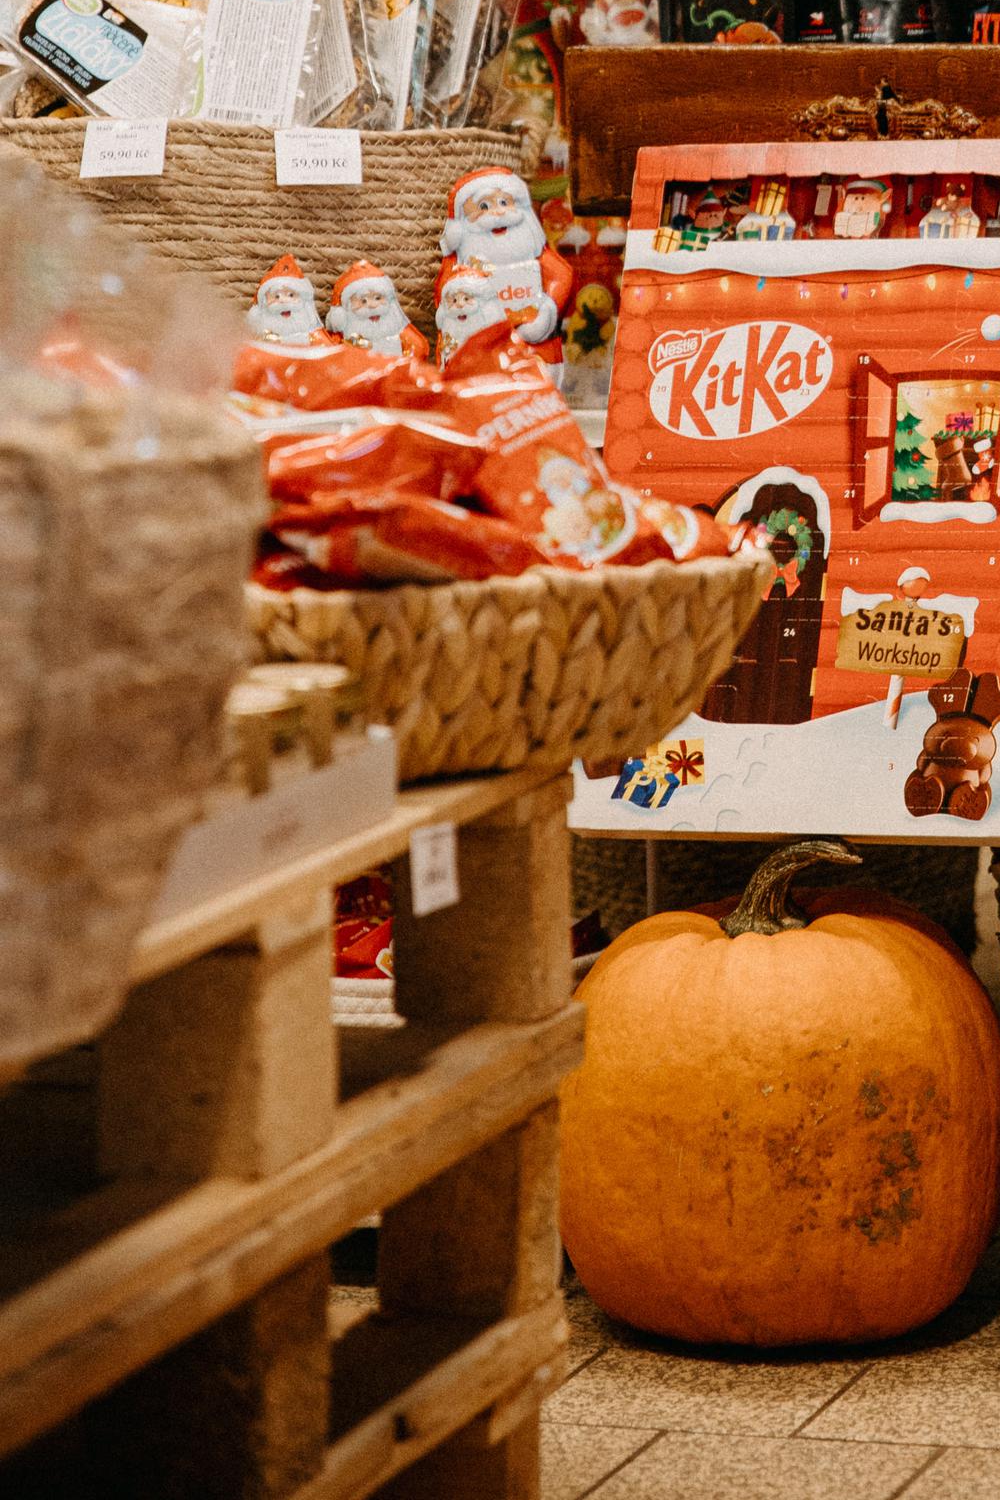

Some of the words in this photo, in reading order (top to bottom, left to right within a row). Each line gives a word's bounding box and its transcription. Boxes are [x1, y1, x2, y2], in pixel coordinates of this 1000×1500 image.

[100, 150, 132, 161] 59,90
[291, 158, 328, 169] 59,90
[332, 157, 349, 168] Kč
[665, 292, 672, 300] 2
[799, 291, 810, 299] 19
[870, 289, 876, 297] 7
[656, 337, 698, 361] Nestlé
[858, 356, 870, 365] 15
[964, 355, 975, 364] 17
[667, 324, 826, 437] KitKat
[646, 452, 652, 460] 6
[844, 489, 855, 498] 21
[849, 557, 859, 565] 11
[989, 557, 995, 565] 8
[855, 608, 953, 637] Santa's
[782, 628, 796, 638] 24
[949, 626, 961, 634] 16
[858, 641, 941, 673] Workshop
[943, 693, 954, 702] 12
